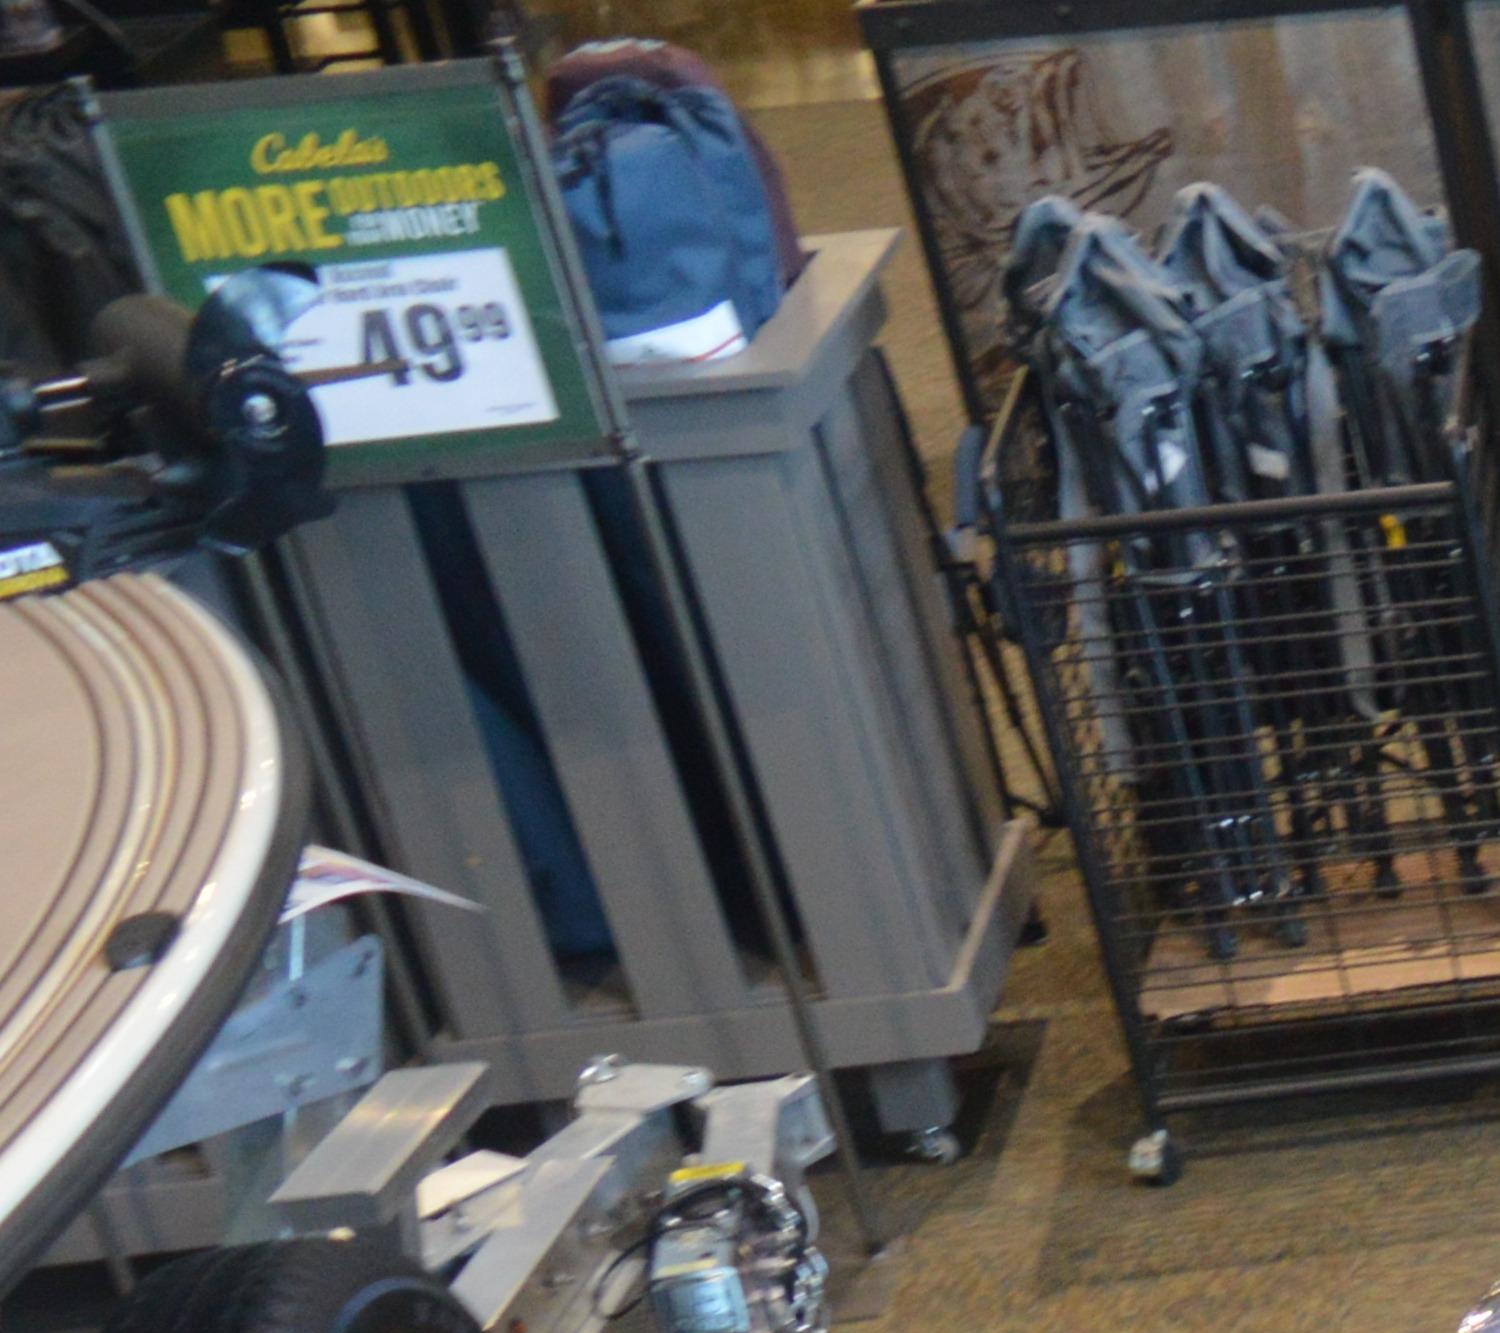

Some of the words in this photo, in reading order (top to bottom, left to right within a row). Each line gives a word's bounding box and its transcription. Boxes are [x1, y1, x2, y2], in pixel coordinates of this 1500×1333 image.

[165, 178, 346, 262] MORE
[328, 160, 505, 216] OUTDOORS
[384, 200, 481, 246] MONEY
